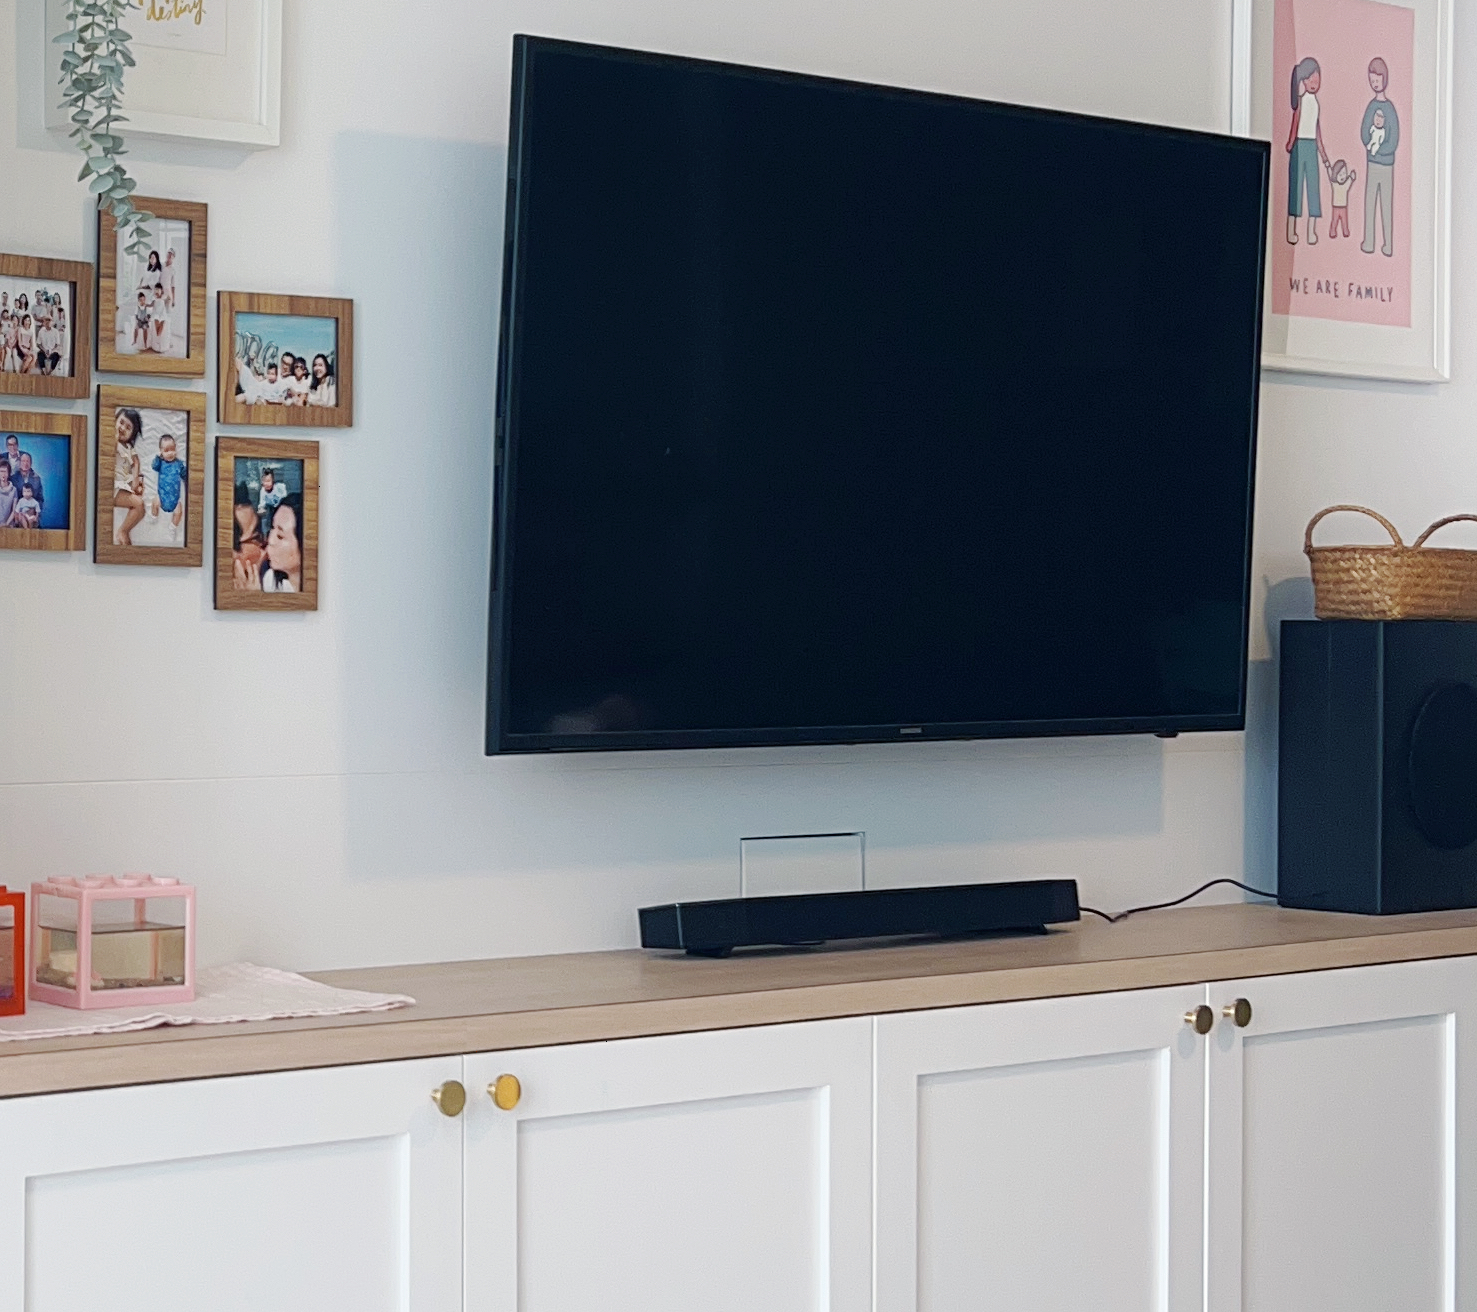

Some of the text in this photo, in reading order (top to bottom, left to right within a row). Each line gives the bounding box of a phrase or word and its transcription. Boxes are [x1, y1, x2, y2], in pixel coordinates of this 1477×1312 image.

[1289, 277, 1394, 303] WE ARE FAMILY
